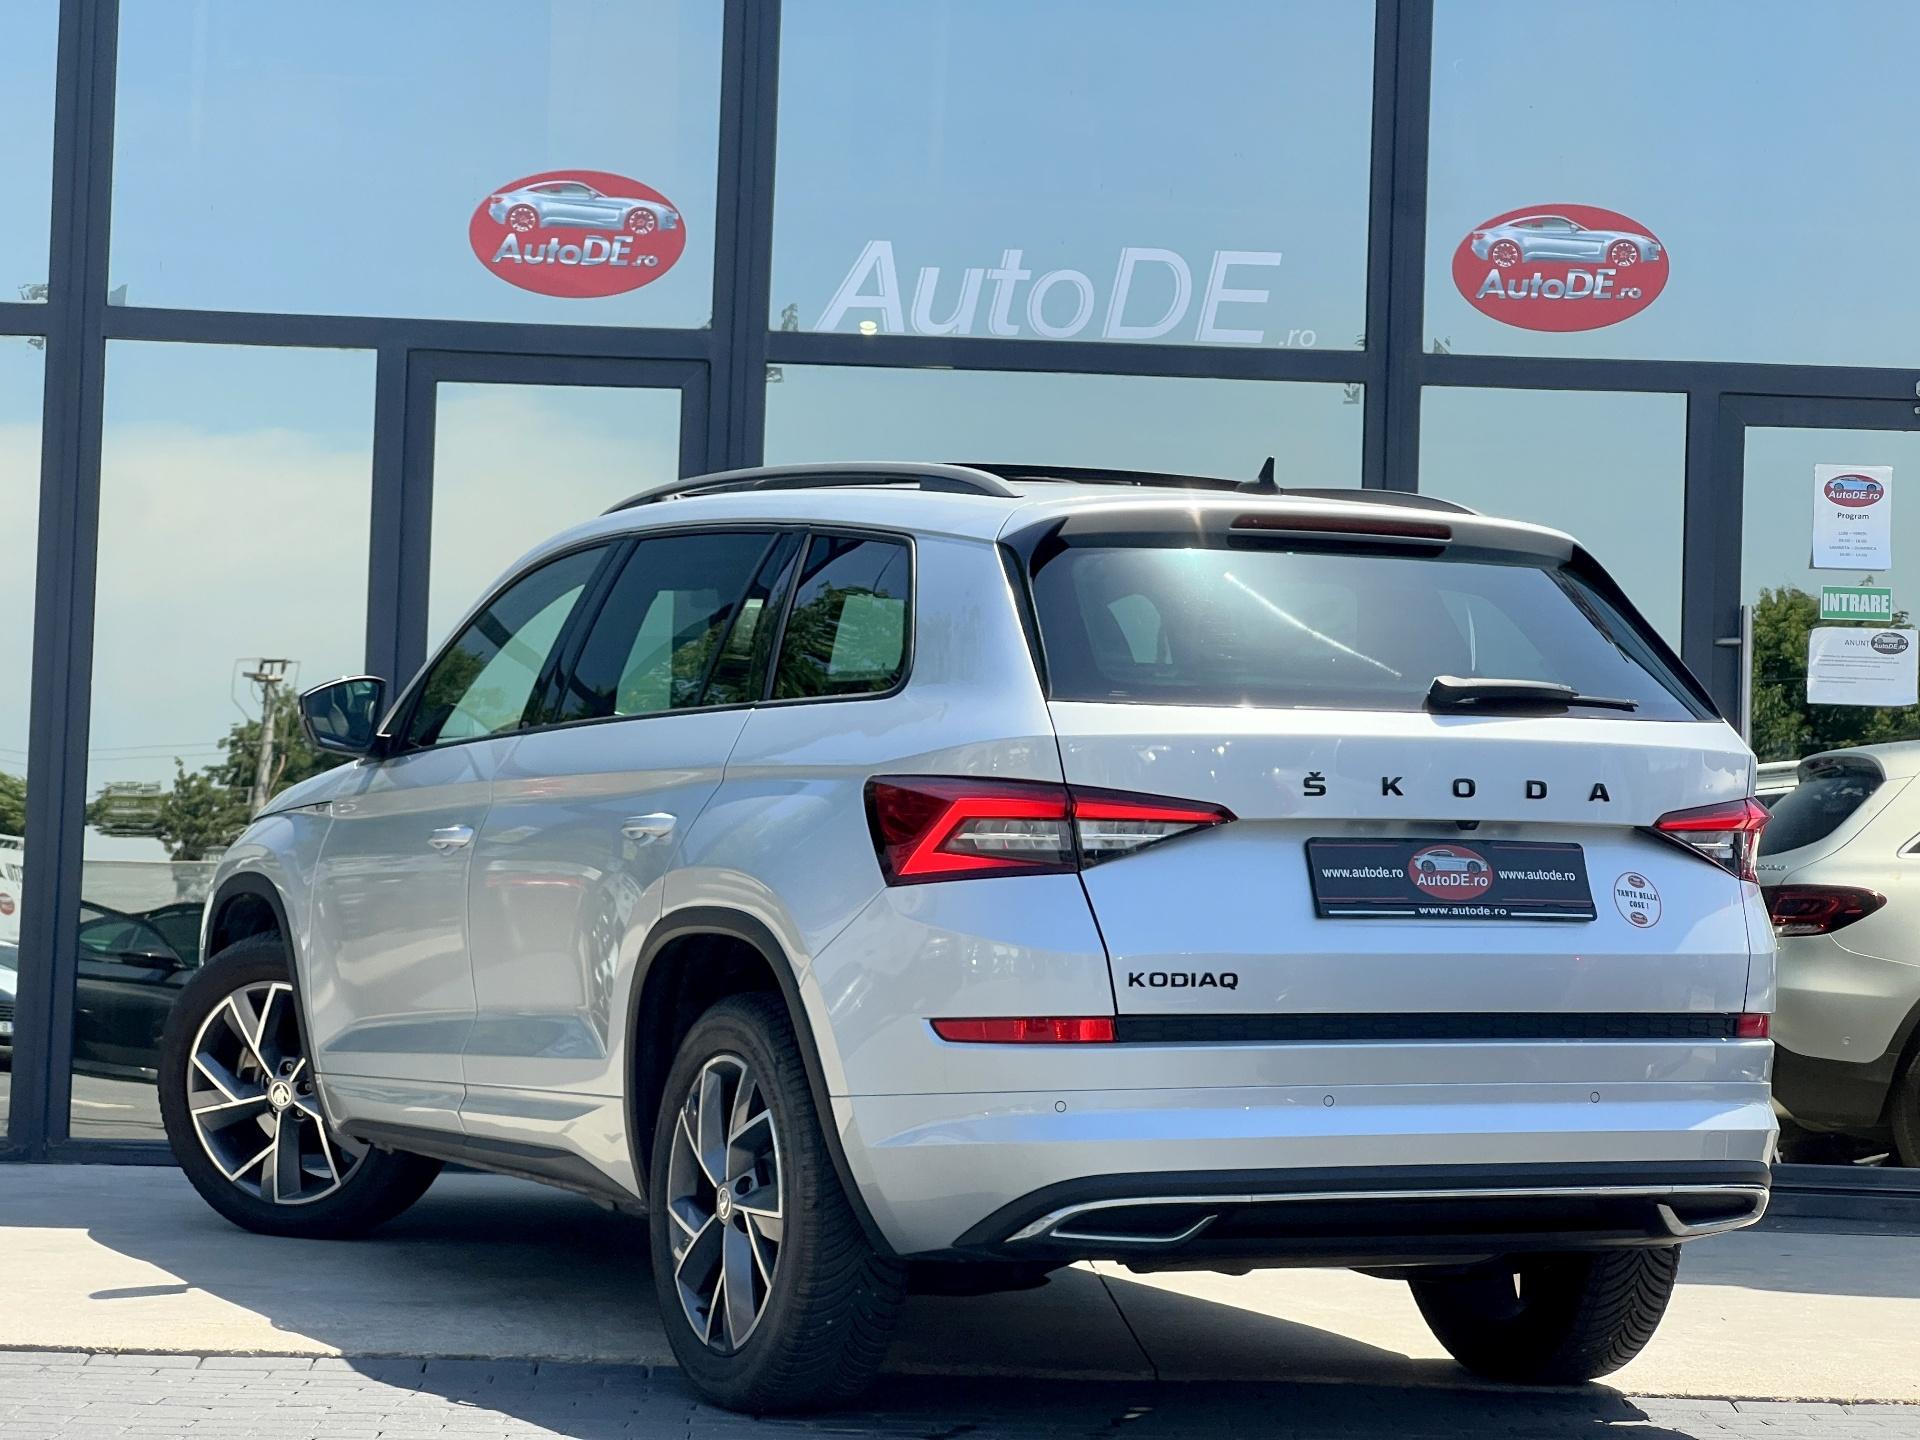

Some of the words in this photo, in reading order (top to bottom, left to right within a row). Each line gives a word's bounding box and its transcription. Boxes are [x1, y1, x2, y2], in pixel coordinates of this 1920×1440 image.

[1828, 490, 1880, 500] AutoDE.ro
[1837, 512, 1870, 520] Program
[1823, 592, 1889, 613] INTRARE
[1321, 866, 1404, 879] www.autode.ro
[1498, 869, 1576, 882] www.autode.ro
[1416, 873, 1488, 887] AutoDE.ro
[1418, 905, 1507, 917] www.autode.ro
[1128, 972, 1239, 990] KODIAQ
